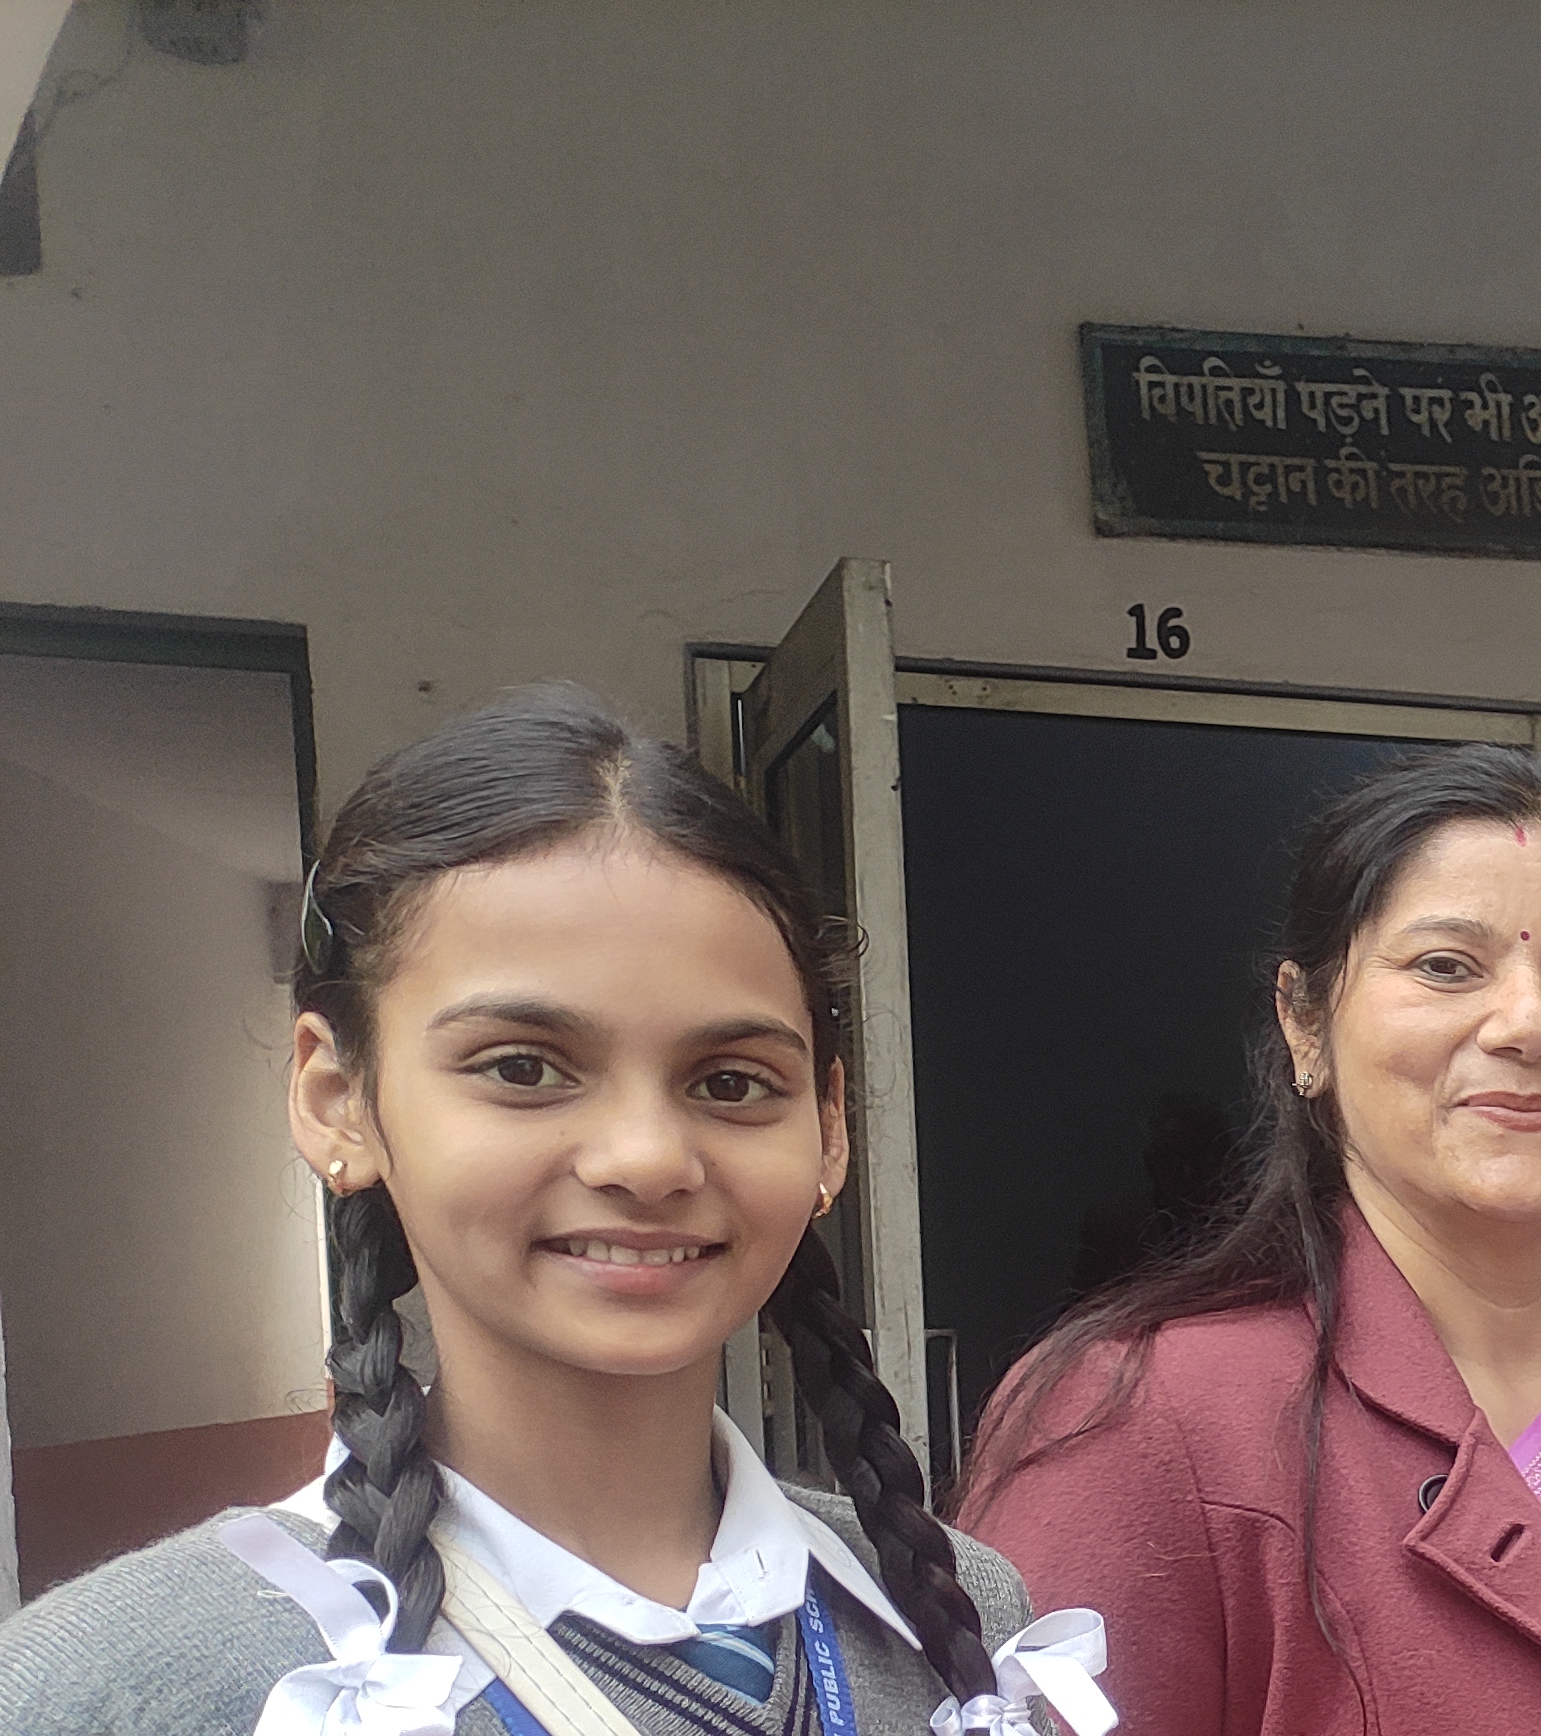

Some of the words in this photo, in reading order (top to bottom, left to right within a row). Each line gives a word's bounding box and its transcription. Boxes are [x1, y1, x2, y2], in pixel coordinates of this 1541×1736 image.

[1299, 367, 1390, 444] पड़ने
[1400, 387, 1454, 442] पर
[1460, 372, 1512, 443] भी
[1200, 450, 1317, 511] चट्टान
[1326, 444, 1379, 508] की
[1388, 461, 1469, 524] तरह
[1125, 602, 1191, 661] 16
[814, 1639, 846, 1728] PUBLIC
